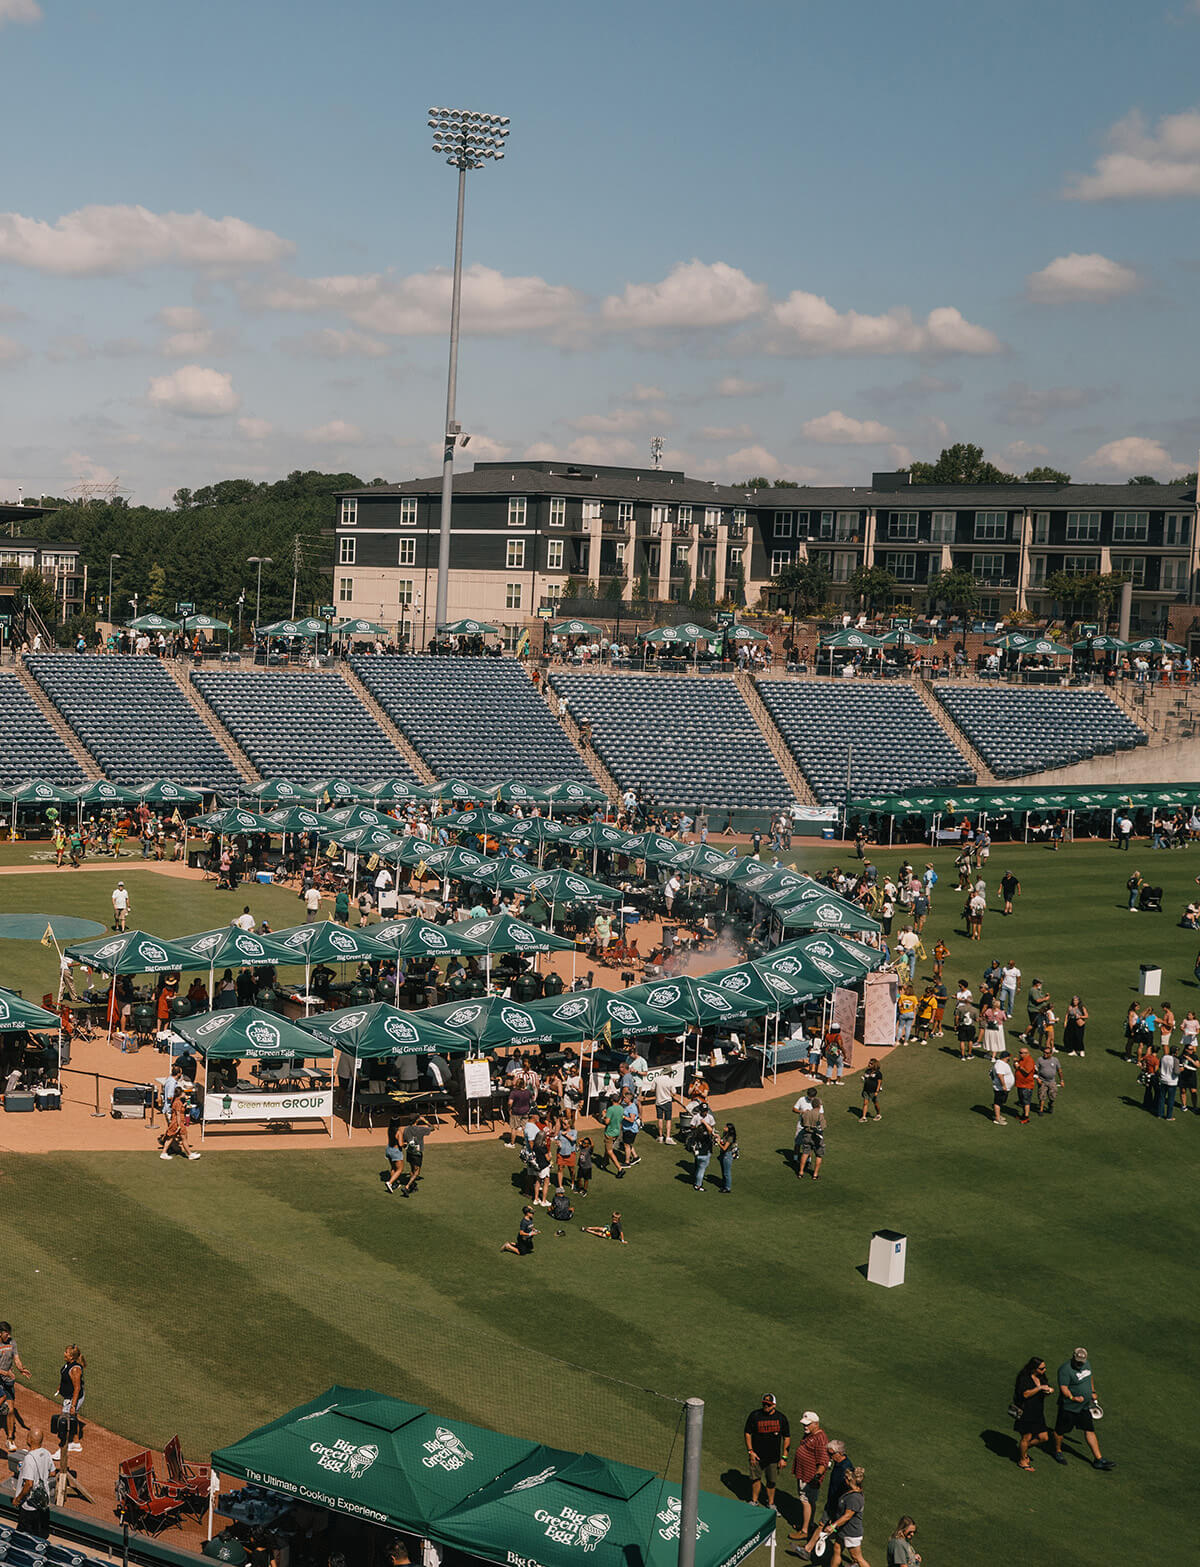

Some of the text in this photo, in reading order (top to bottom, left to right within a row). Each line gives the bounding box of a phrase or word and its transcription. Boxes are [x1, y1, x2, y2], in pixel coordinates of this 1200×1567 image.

[12, 1021, 25, 1029] Egg
[246, 1049, 259, 1057] Big
[280, 1049, 295, 1057] Egg
[392, 1046, 405, 1054] Big
[423, 1044, 437, 1052] Egg
[647, 1070, 678, 1082] GRP
[237, 1097, 325, 1110] Green Man GROUP
[309, 1442, 350, 1462] Green
[332, 1439, 358, 1454] Big
[422, 1440, 444, 1454] Big
[317, 1456, 345, 1473] Egg
[422, 1447, 452, 1469] Green
[439, 1454, 464, 1471] Egg
[245, 1468, 387, 1522] The Ultimate Cooking Experience
[534, 1509, 579, 1534] Green
[559, 1506, 587, 1525] Big
[656, 1509, 679, 1525] Big
[544, 1525, 576, 1546] Egg
